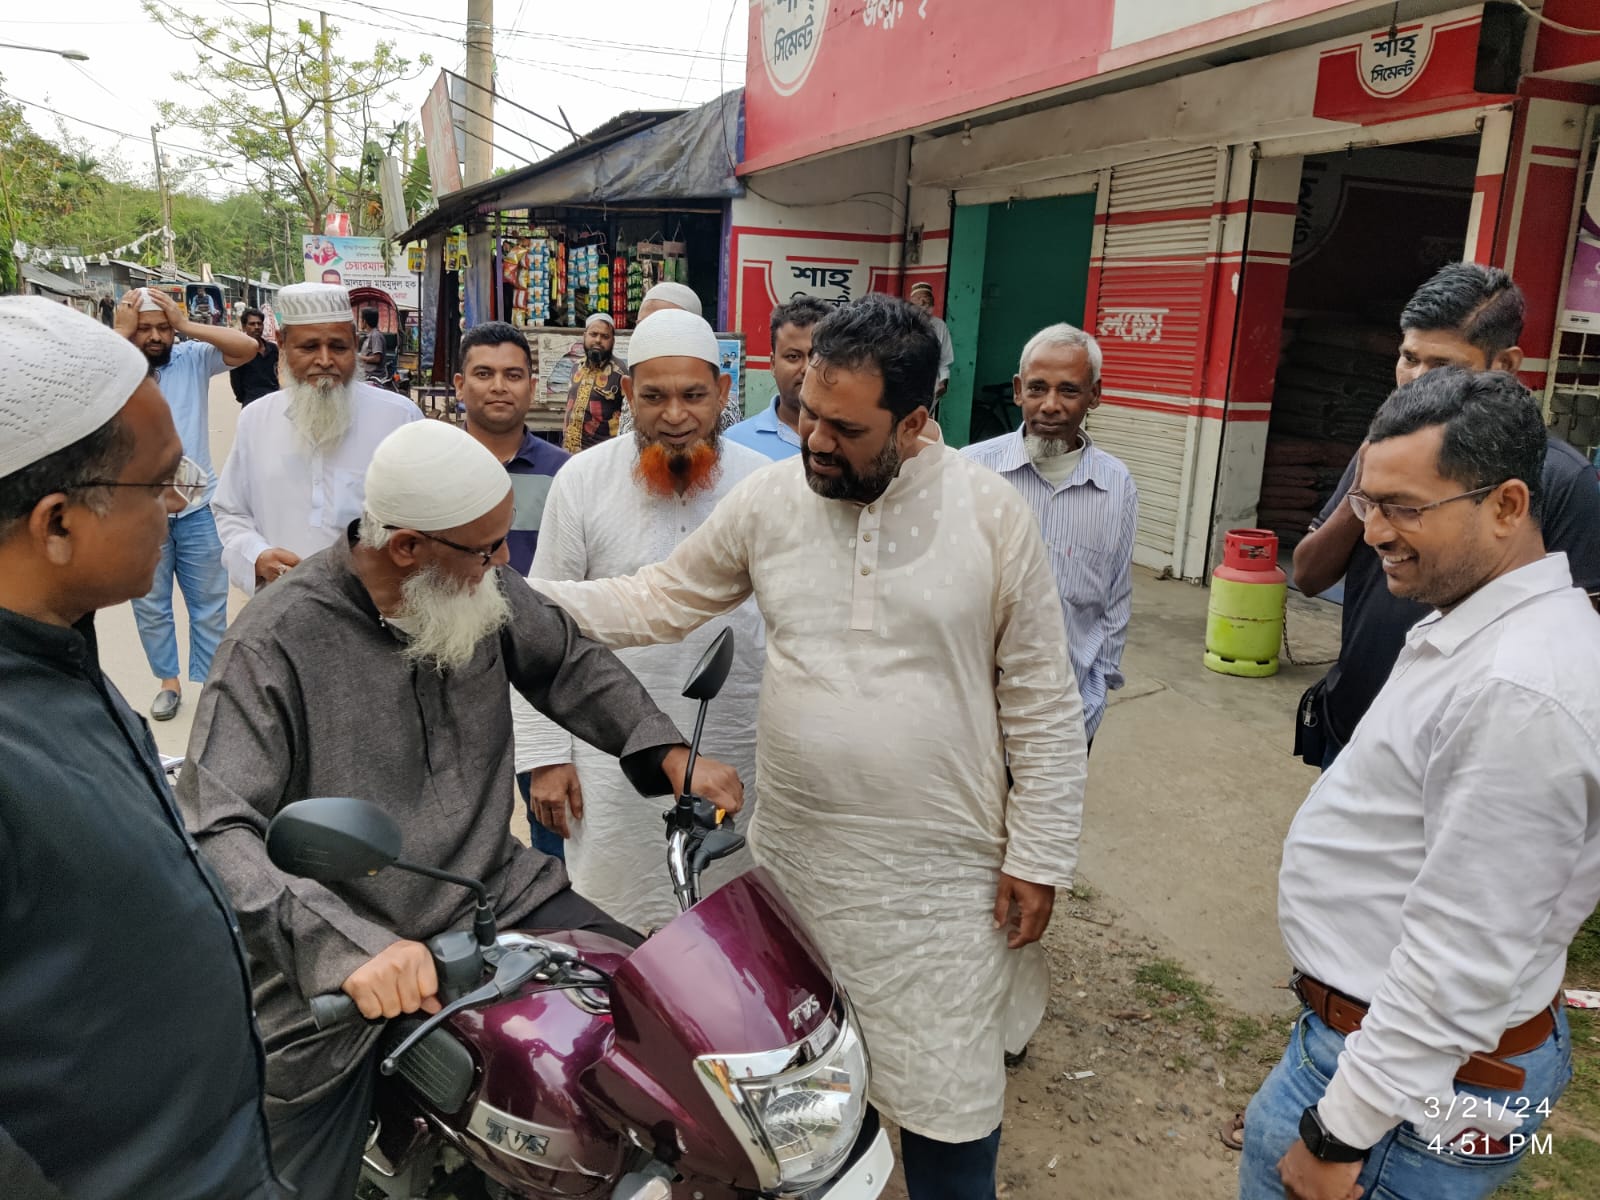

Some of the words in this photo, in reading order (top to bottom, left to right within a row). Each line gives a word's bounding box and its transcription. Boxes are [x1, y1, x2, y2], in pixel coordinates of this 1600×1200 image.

[774, 14, 814, 65] সিমেন্ট
[1371, 59, 1414, 83] সিমেন্ট
[788, 994, 820, 1030] TVS
[486, 1116, 551, 1156] TVS
